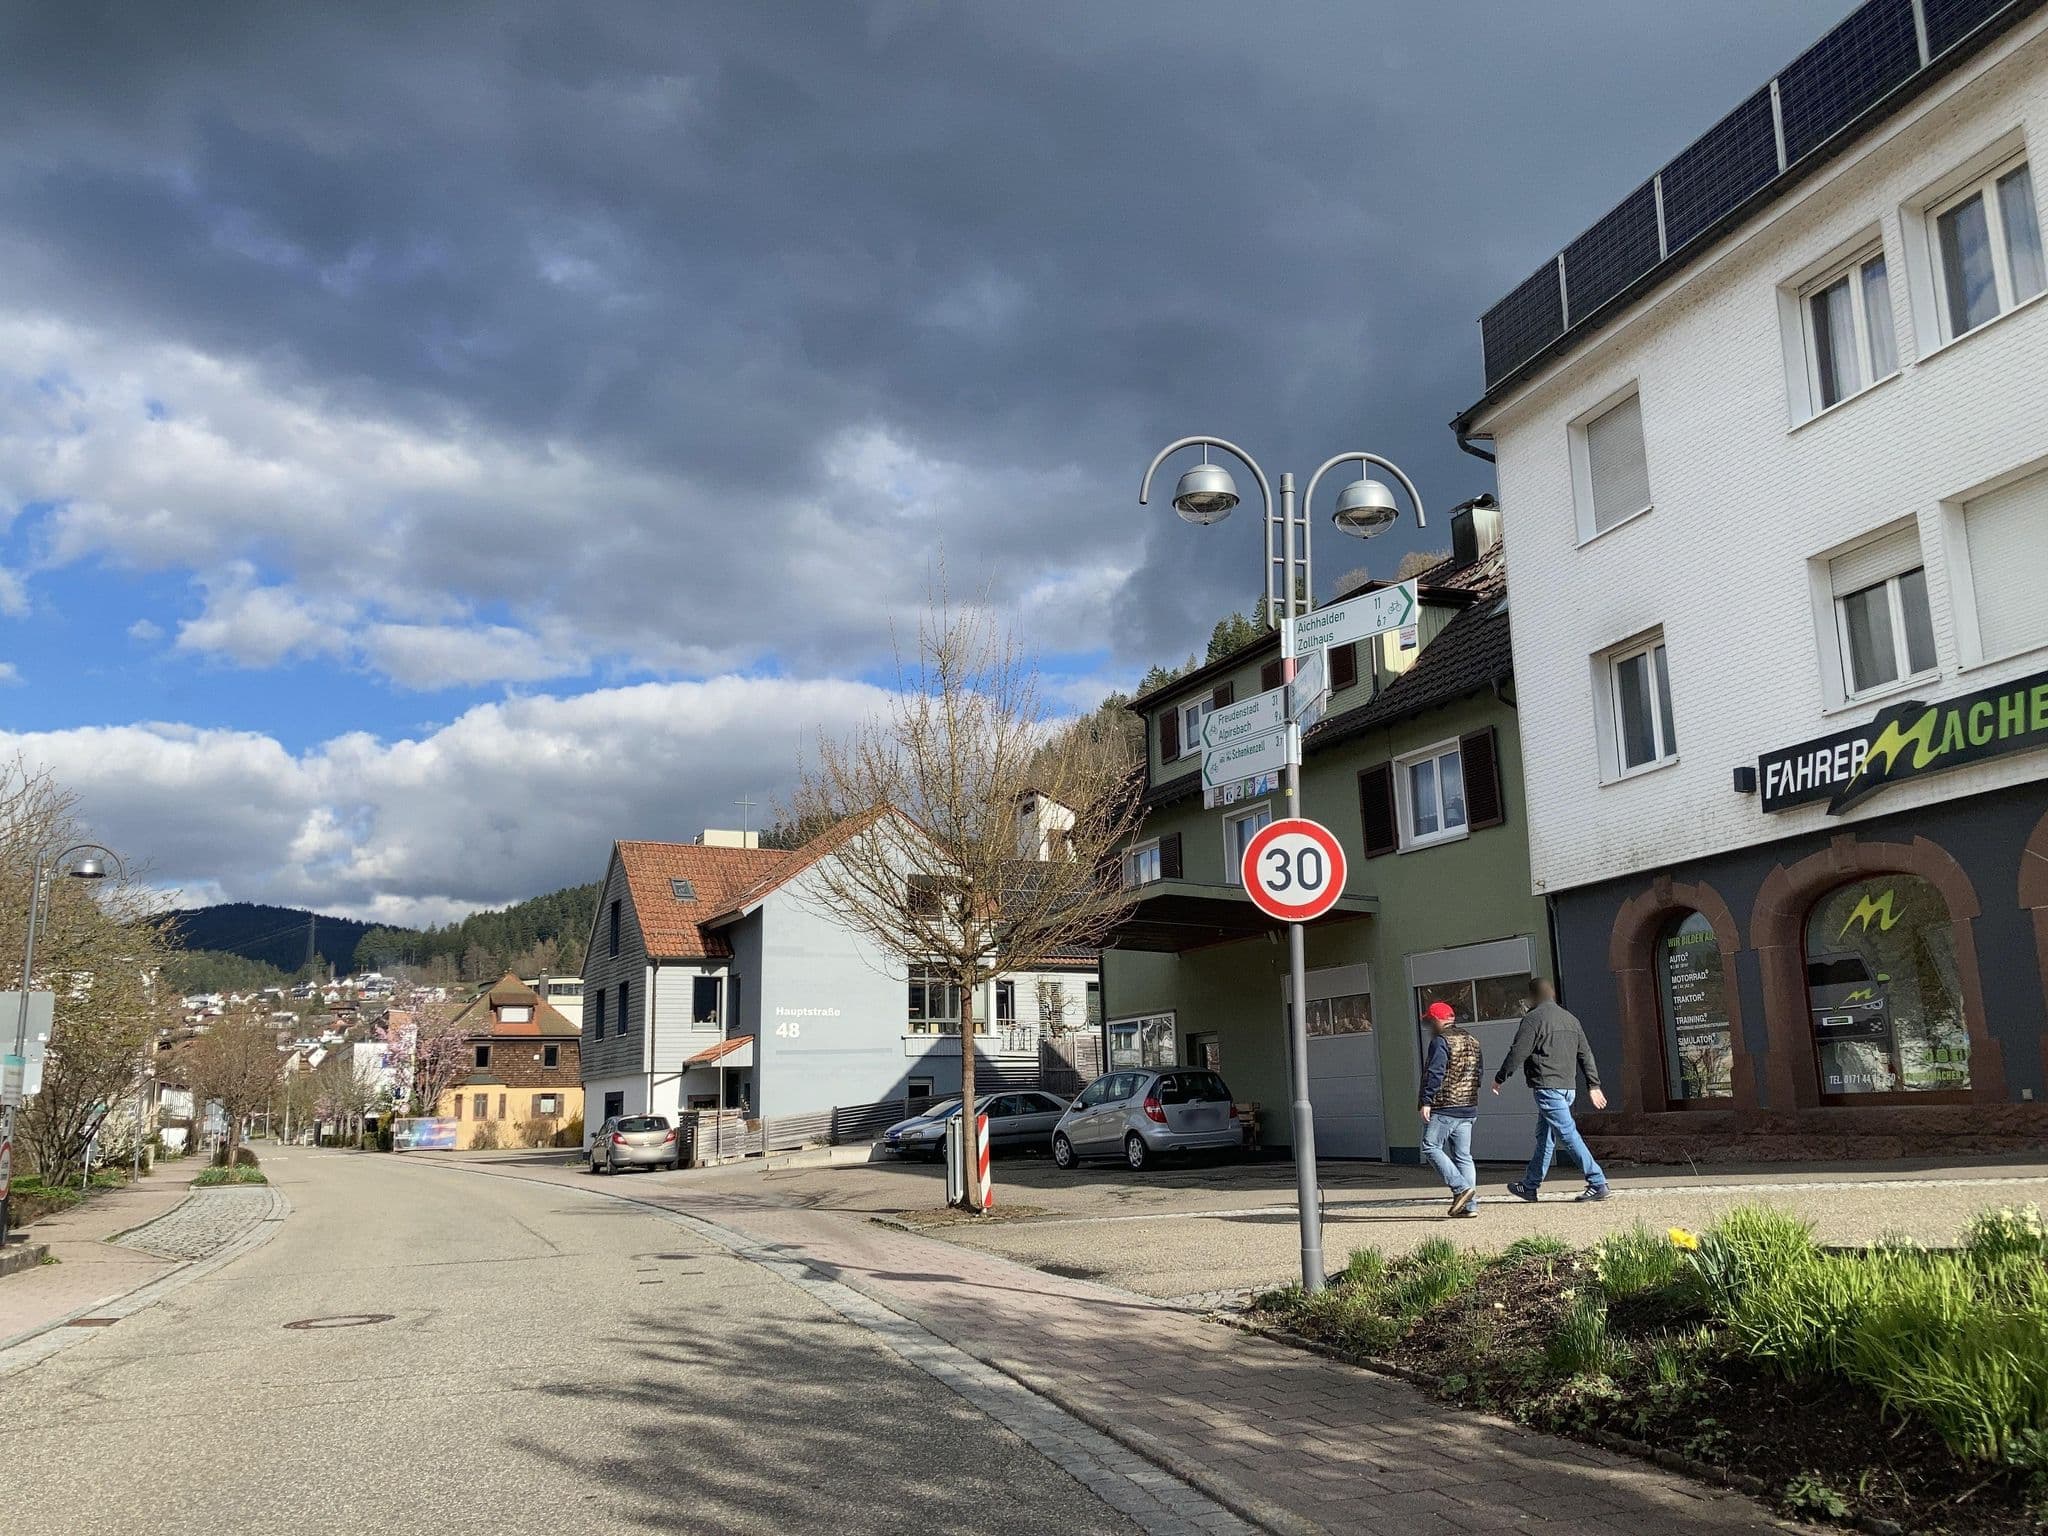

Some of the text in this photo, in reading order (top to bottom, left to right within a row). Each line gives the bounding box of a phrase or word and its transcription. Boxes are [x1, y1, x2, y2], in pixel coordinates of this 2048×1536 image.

[1297, 611, 1345, 634] Aichhalden
[1297, 631, 1334, 651] Zollhaus
[1218, 703, 1260, 725] Freudenstadt
[1218, 722, 1252, 741] Alpirsbach
[1265, 847, 1323, 891] 30
[776, 1006, 840, 1017] Hauptstraße
[776, 1022, 800, 1038] 48
